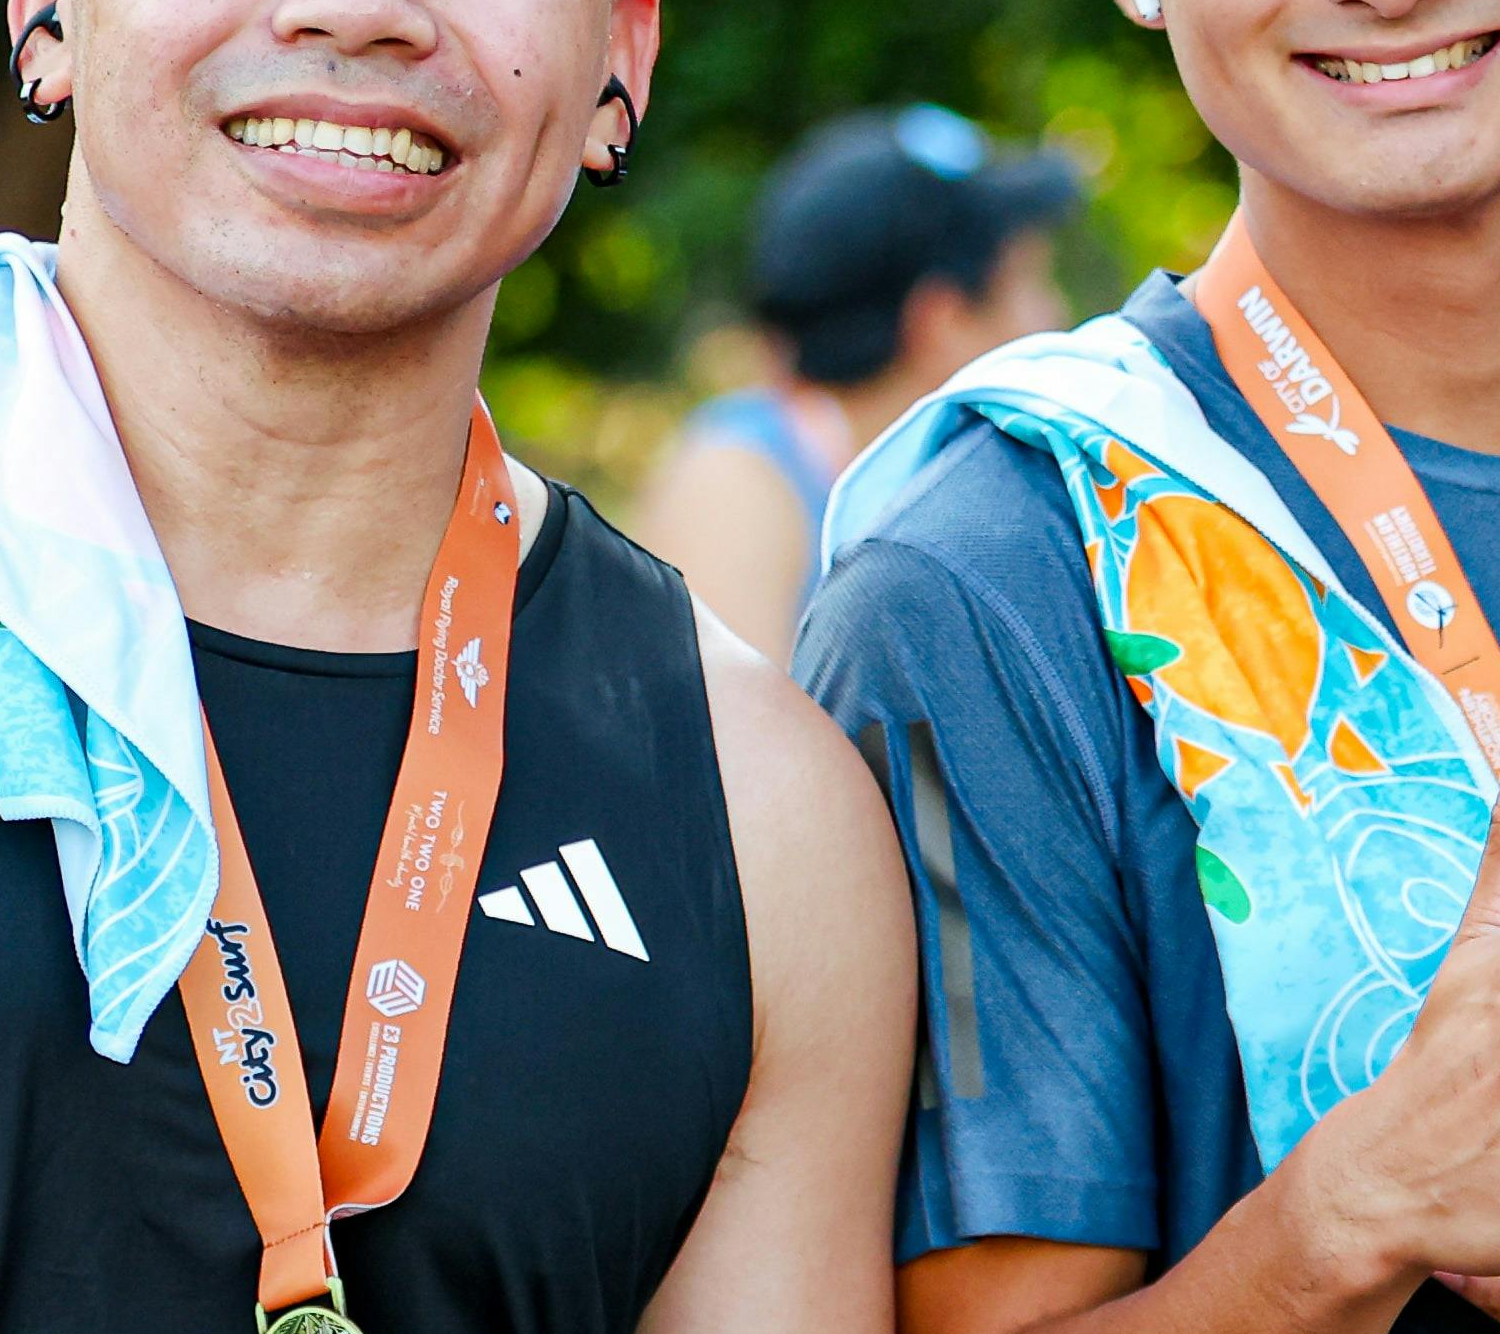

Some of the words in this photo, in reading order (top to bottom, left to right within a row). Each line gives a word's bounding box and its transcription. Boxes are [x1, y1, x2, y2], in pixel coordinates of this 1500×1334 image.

[1236, 285, 1333, 406] DARWIN
[1257, 359, 1282, 381] OF
[1272, 379, 1307, 414] CITY
[438, 575, 459, 618] Royal
[432, 615, 453, 653] Flying
[430, 652, 449, 691] Doctor
[428, 691, 446, 735] Service
[425, 790, 448, 829] TWO
[415, 834, 437, 871] TWO
[405, 875, 425, 911] ONE
[213, 1027, 240, 1065] NT
[360, 1044, 398, 1147] PRODUCTIONS
